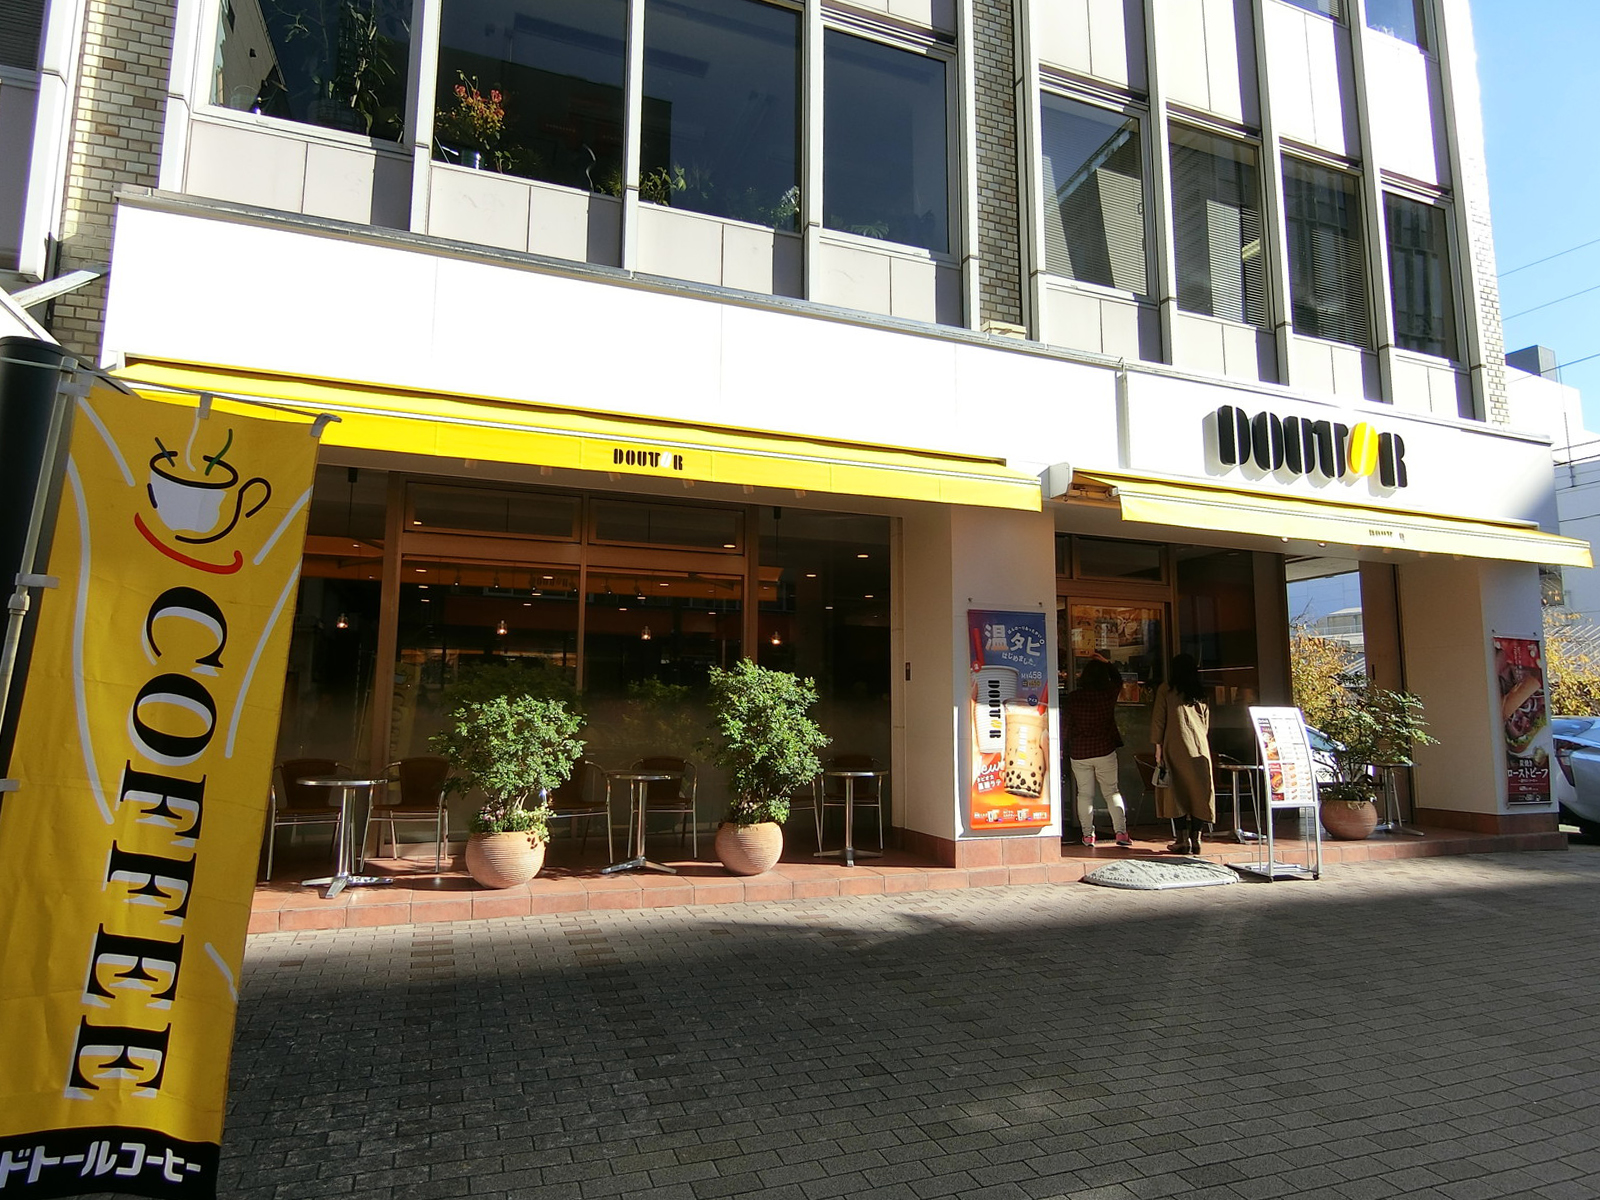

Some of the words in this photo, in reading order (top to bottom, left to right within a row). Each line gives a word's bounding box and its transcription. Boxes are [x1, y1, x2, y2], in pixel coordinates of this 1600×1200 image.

[613, 448, 683, 471] DOUTOR
[1217, 405, 1408, 489] DOUTOR
[1369, 529, 1406, 543] DOUTR
[988, 680, 1003, 739] DOUTOR
[1507, 767, 1549, 779] ローストビーフ
[66, 586, 228, 1097] COFFEE
[0, 1140, 201, 1189] ドトールコーヒー
